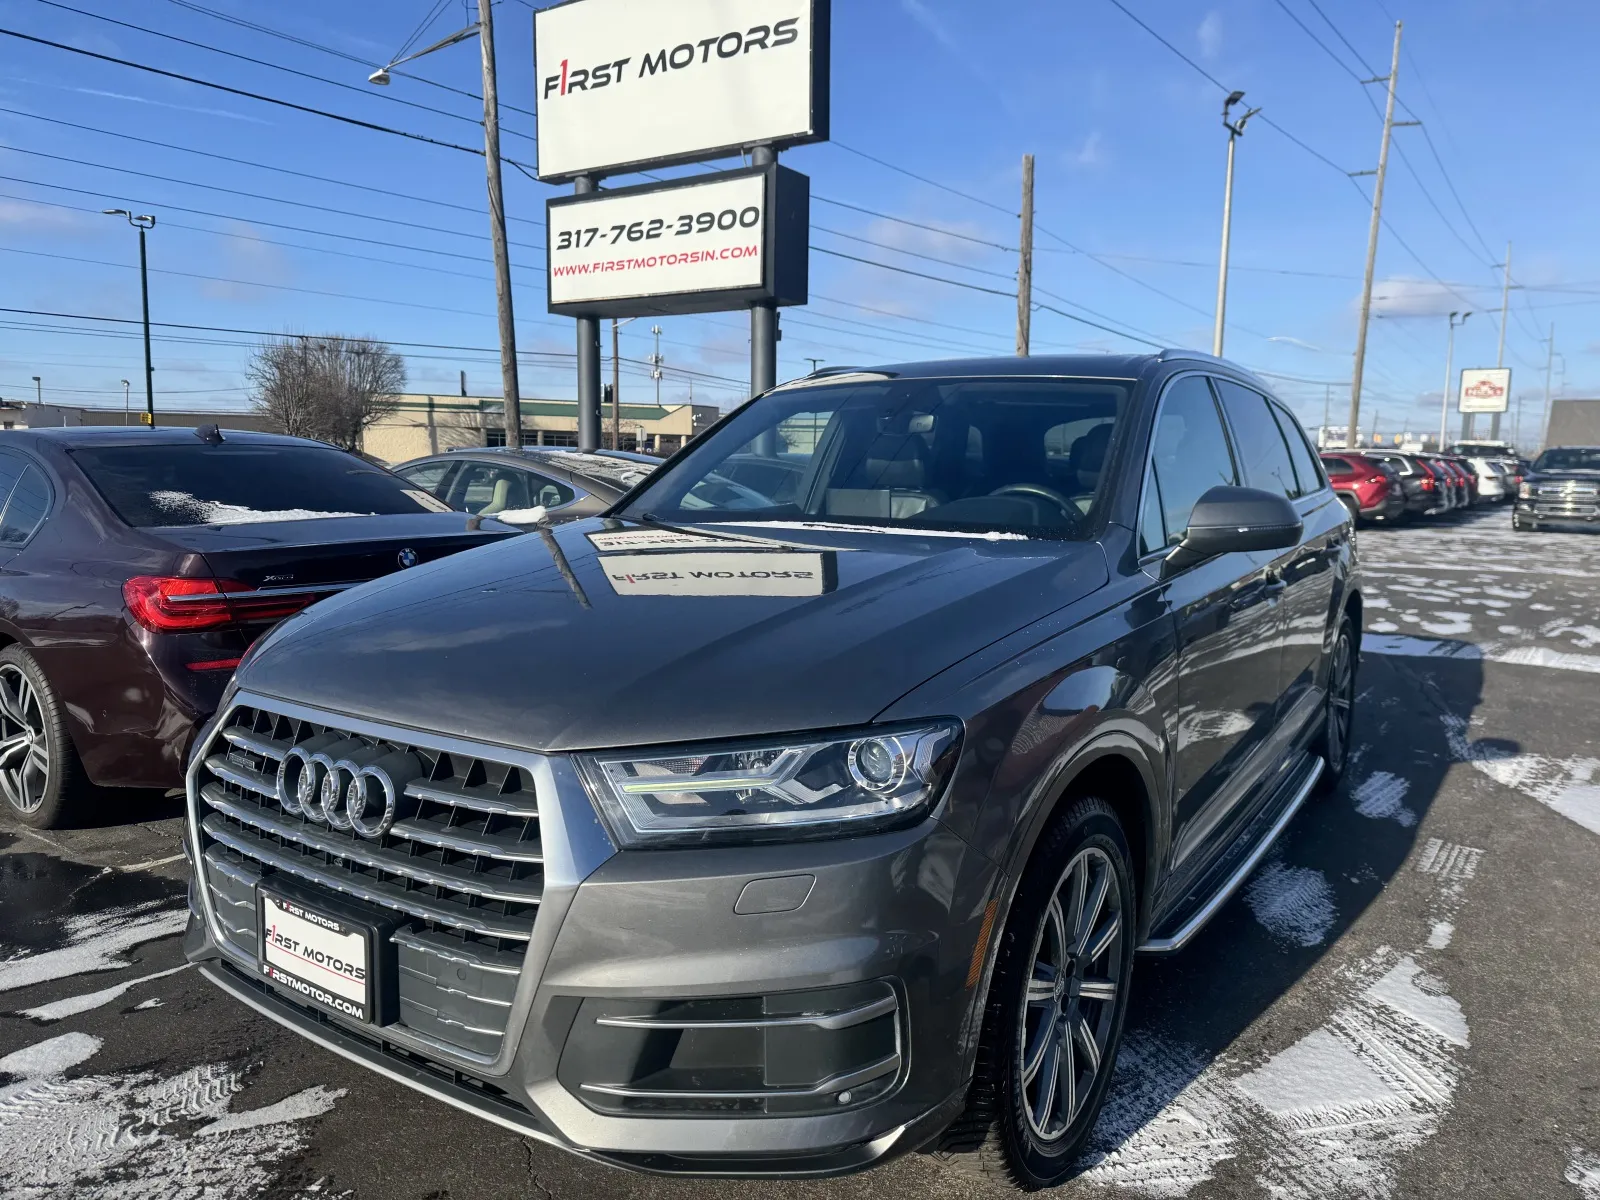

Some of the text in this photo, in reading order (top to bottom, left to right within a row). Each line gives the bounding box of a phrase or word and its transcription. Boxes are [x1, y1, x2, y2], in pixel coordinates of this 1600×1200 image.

[638, 17, 800, 78] MOTORS
[556, 206, 760, 250] 317-762-3900
[553, 245, 758, 277] WWW.FIRSTMOTORSIN.COM
[305, 911, 340, 931] MOTORS
[302, 945, 366, 980] MOTORS
